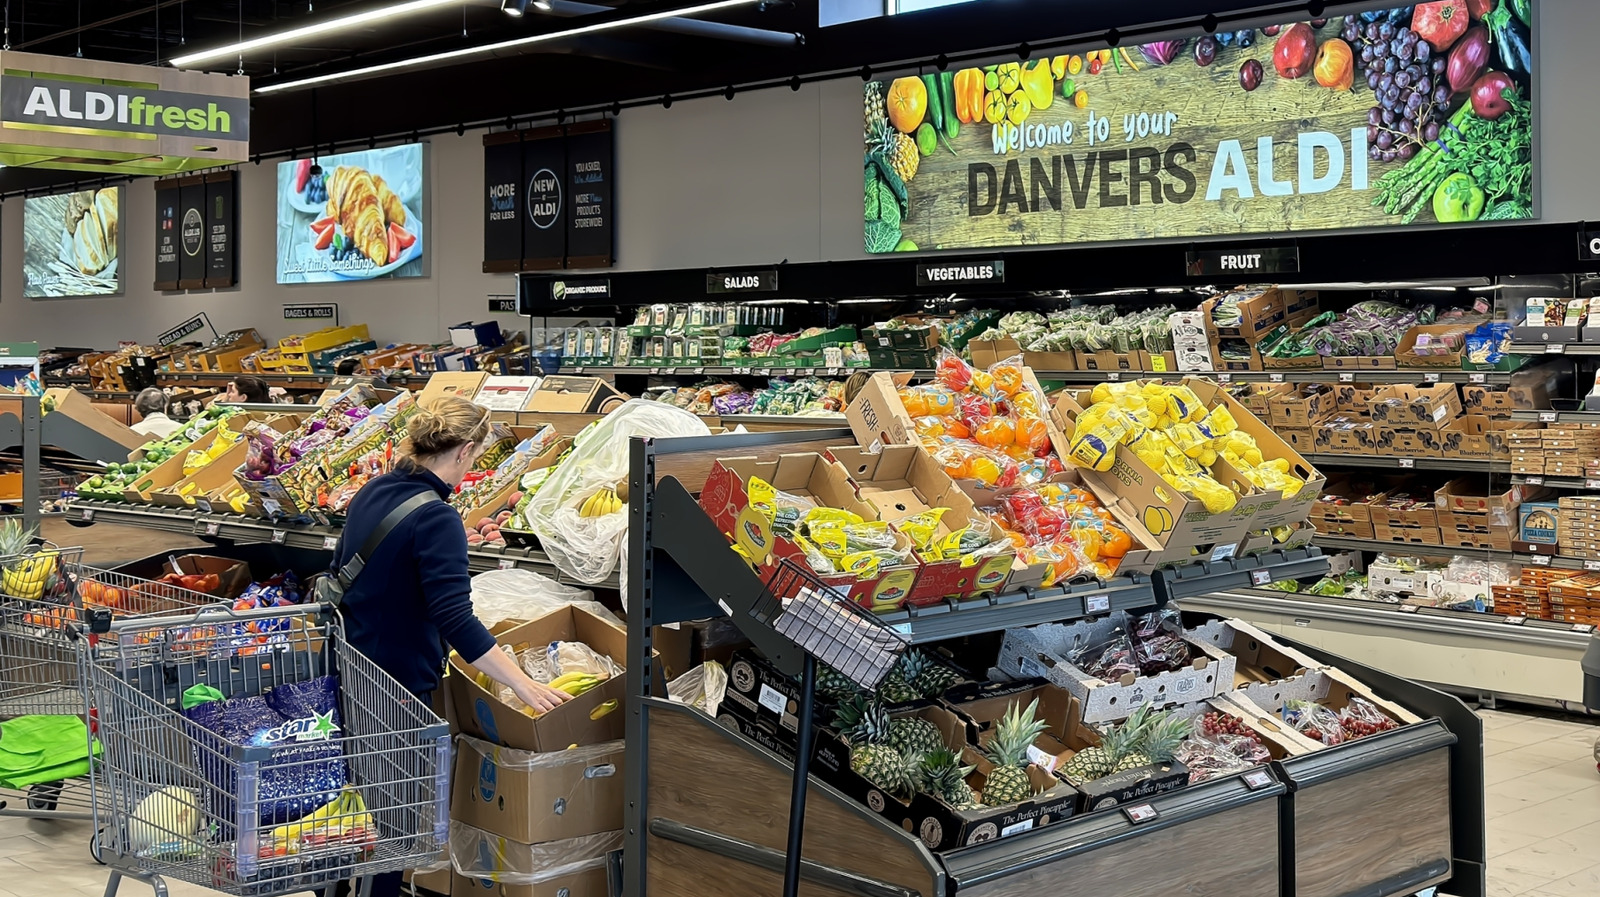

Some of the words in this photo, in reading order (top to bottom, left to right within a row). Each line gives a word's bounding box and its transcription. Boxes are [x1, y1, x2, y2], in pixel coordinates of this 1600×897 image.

[23, 86, 231, 133] ALDIfresh
[991, 121, 1073, 155] Welcome
[1086, 110, 1109, 147] to
[1124, 111, 1178, 143] your
[968, 142, 1197, 217] DANVERS
[1205, 126, 1368, 201] ALDI
[489, 183, 516, 198] MORE
[533, 179, 555, 193] NEW
[575, 194, 589, 204] MORE
[490, 212, 501, 221] FOR
[501, 211, 515, 219] LESS
[533, 202, 556, 216] ALDI
[576, 205, 601, 216] PRODUCTS
[283, 258, 307, 274] Sweet
[328, 253, 374, 275] Somethings
[1220, 254, 1261, 270] FRUIT
[926, 265, 994, 281] VEGETABLES
[565, 286, 586, 294] ORGANIC
[724, 276, 760, 289] SALADS
[284, 309, 307, 318] BAGELS
[314, 308, 331, 317] ROLLS
[161, 331, 182, 346] BREAD
[184, 319, 202, 333] BUNS
[860, 399, 879, 431] FRESH
[760, 670, 769, 683] The
[770, 677, 789, 694] Perfect
[266, 718, 317, 741] star
[298, 730, 323, 740] market
[744, 723, 755, 737] The
[756, 731, 775, 749] Perfect
[1123, 790, 1134, 800] The
[1154, 778, 1183, 791] Pineapple
[1002, 816, 1015, 825] The
[1017, 810, 1039, 821] Perfect
[1040, 800, 1071, 815] Pineapple
